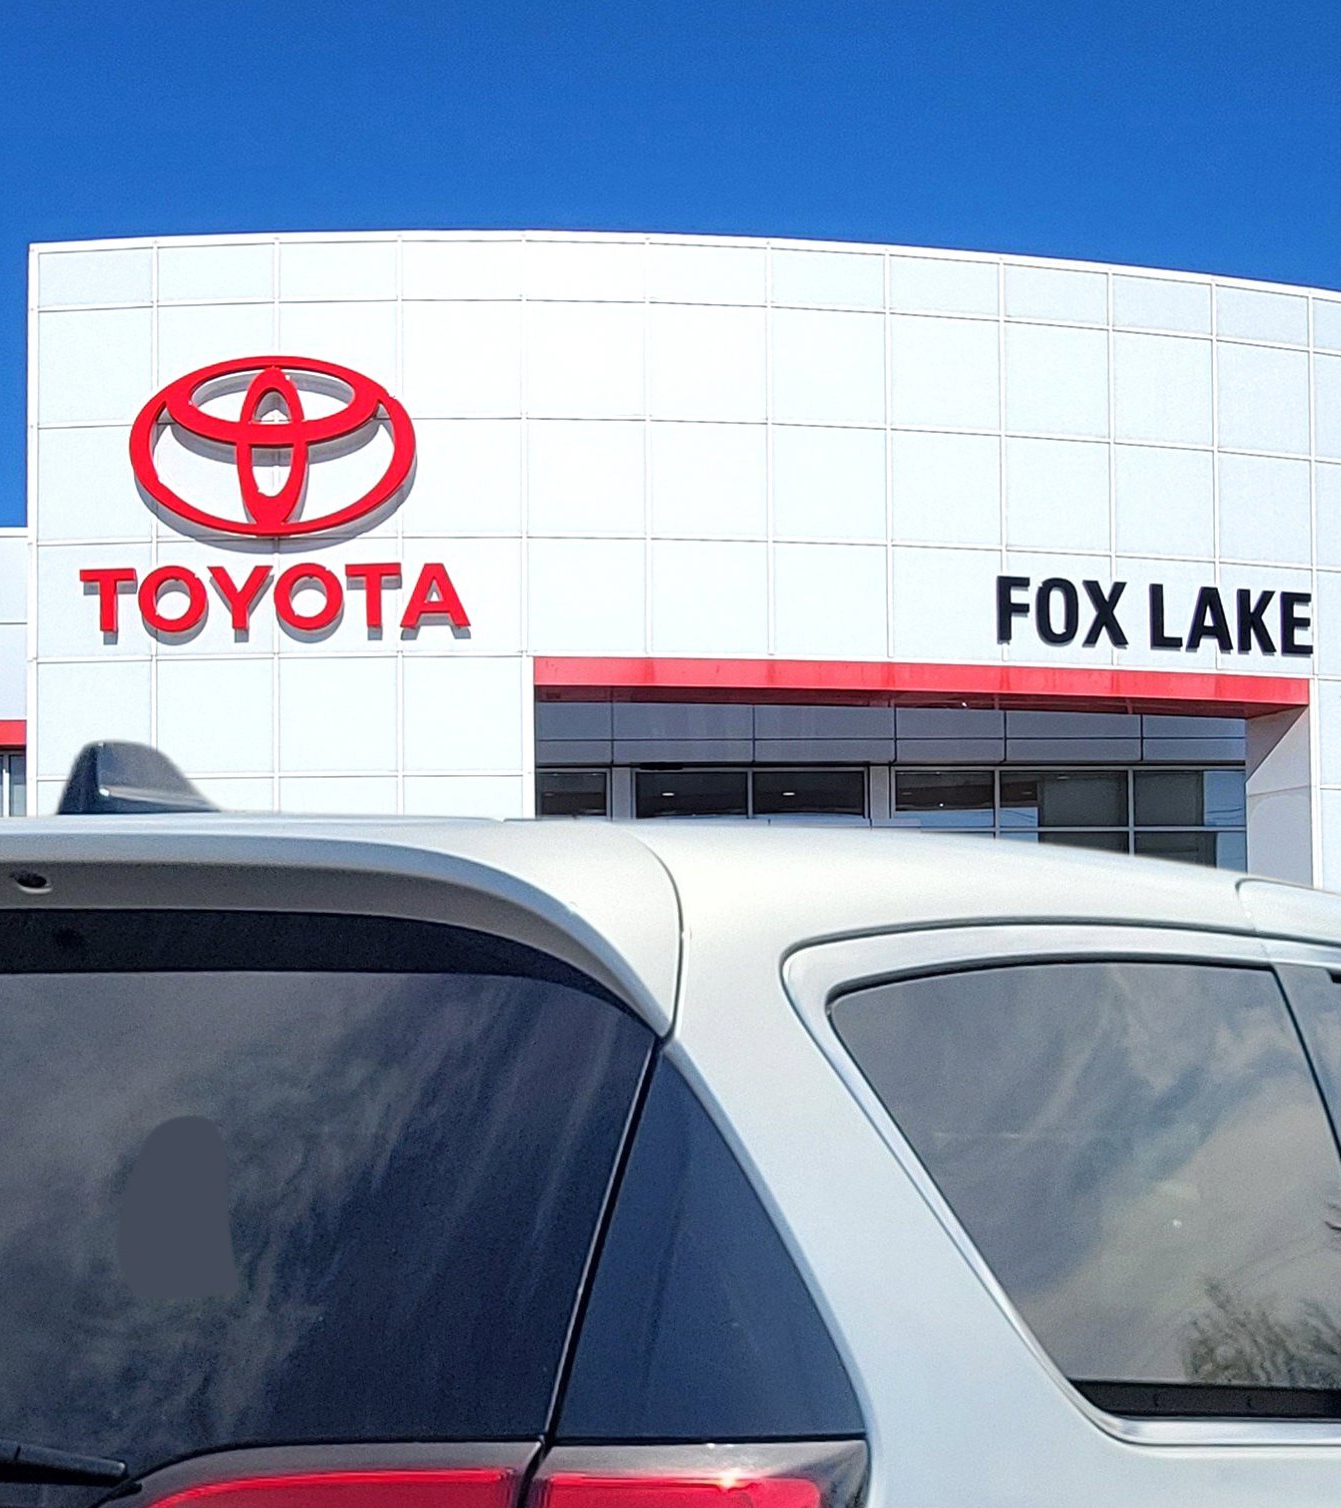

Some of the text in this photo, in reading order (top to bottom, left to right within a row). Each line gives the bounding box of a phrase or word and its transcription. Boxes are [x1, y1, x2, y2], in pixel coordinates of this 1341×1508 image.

[80, 562, 471, 645] TOYOTA
[996, 575, 1314, 657] FOX LAKE
